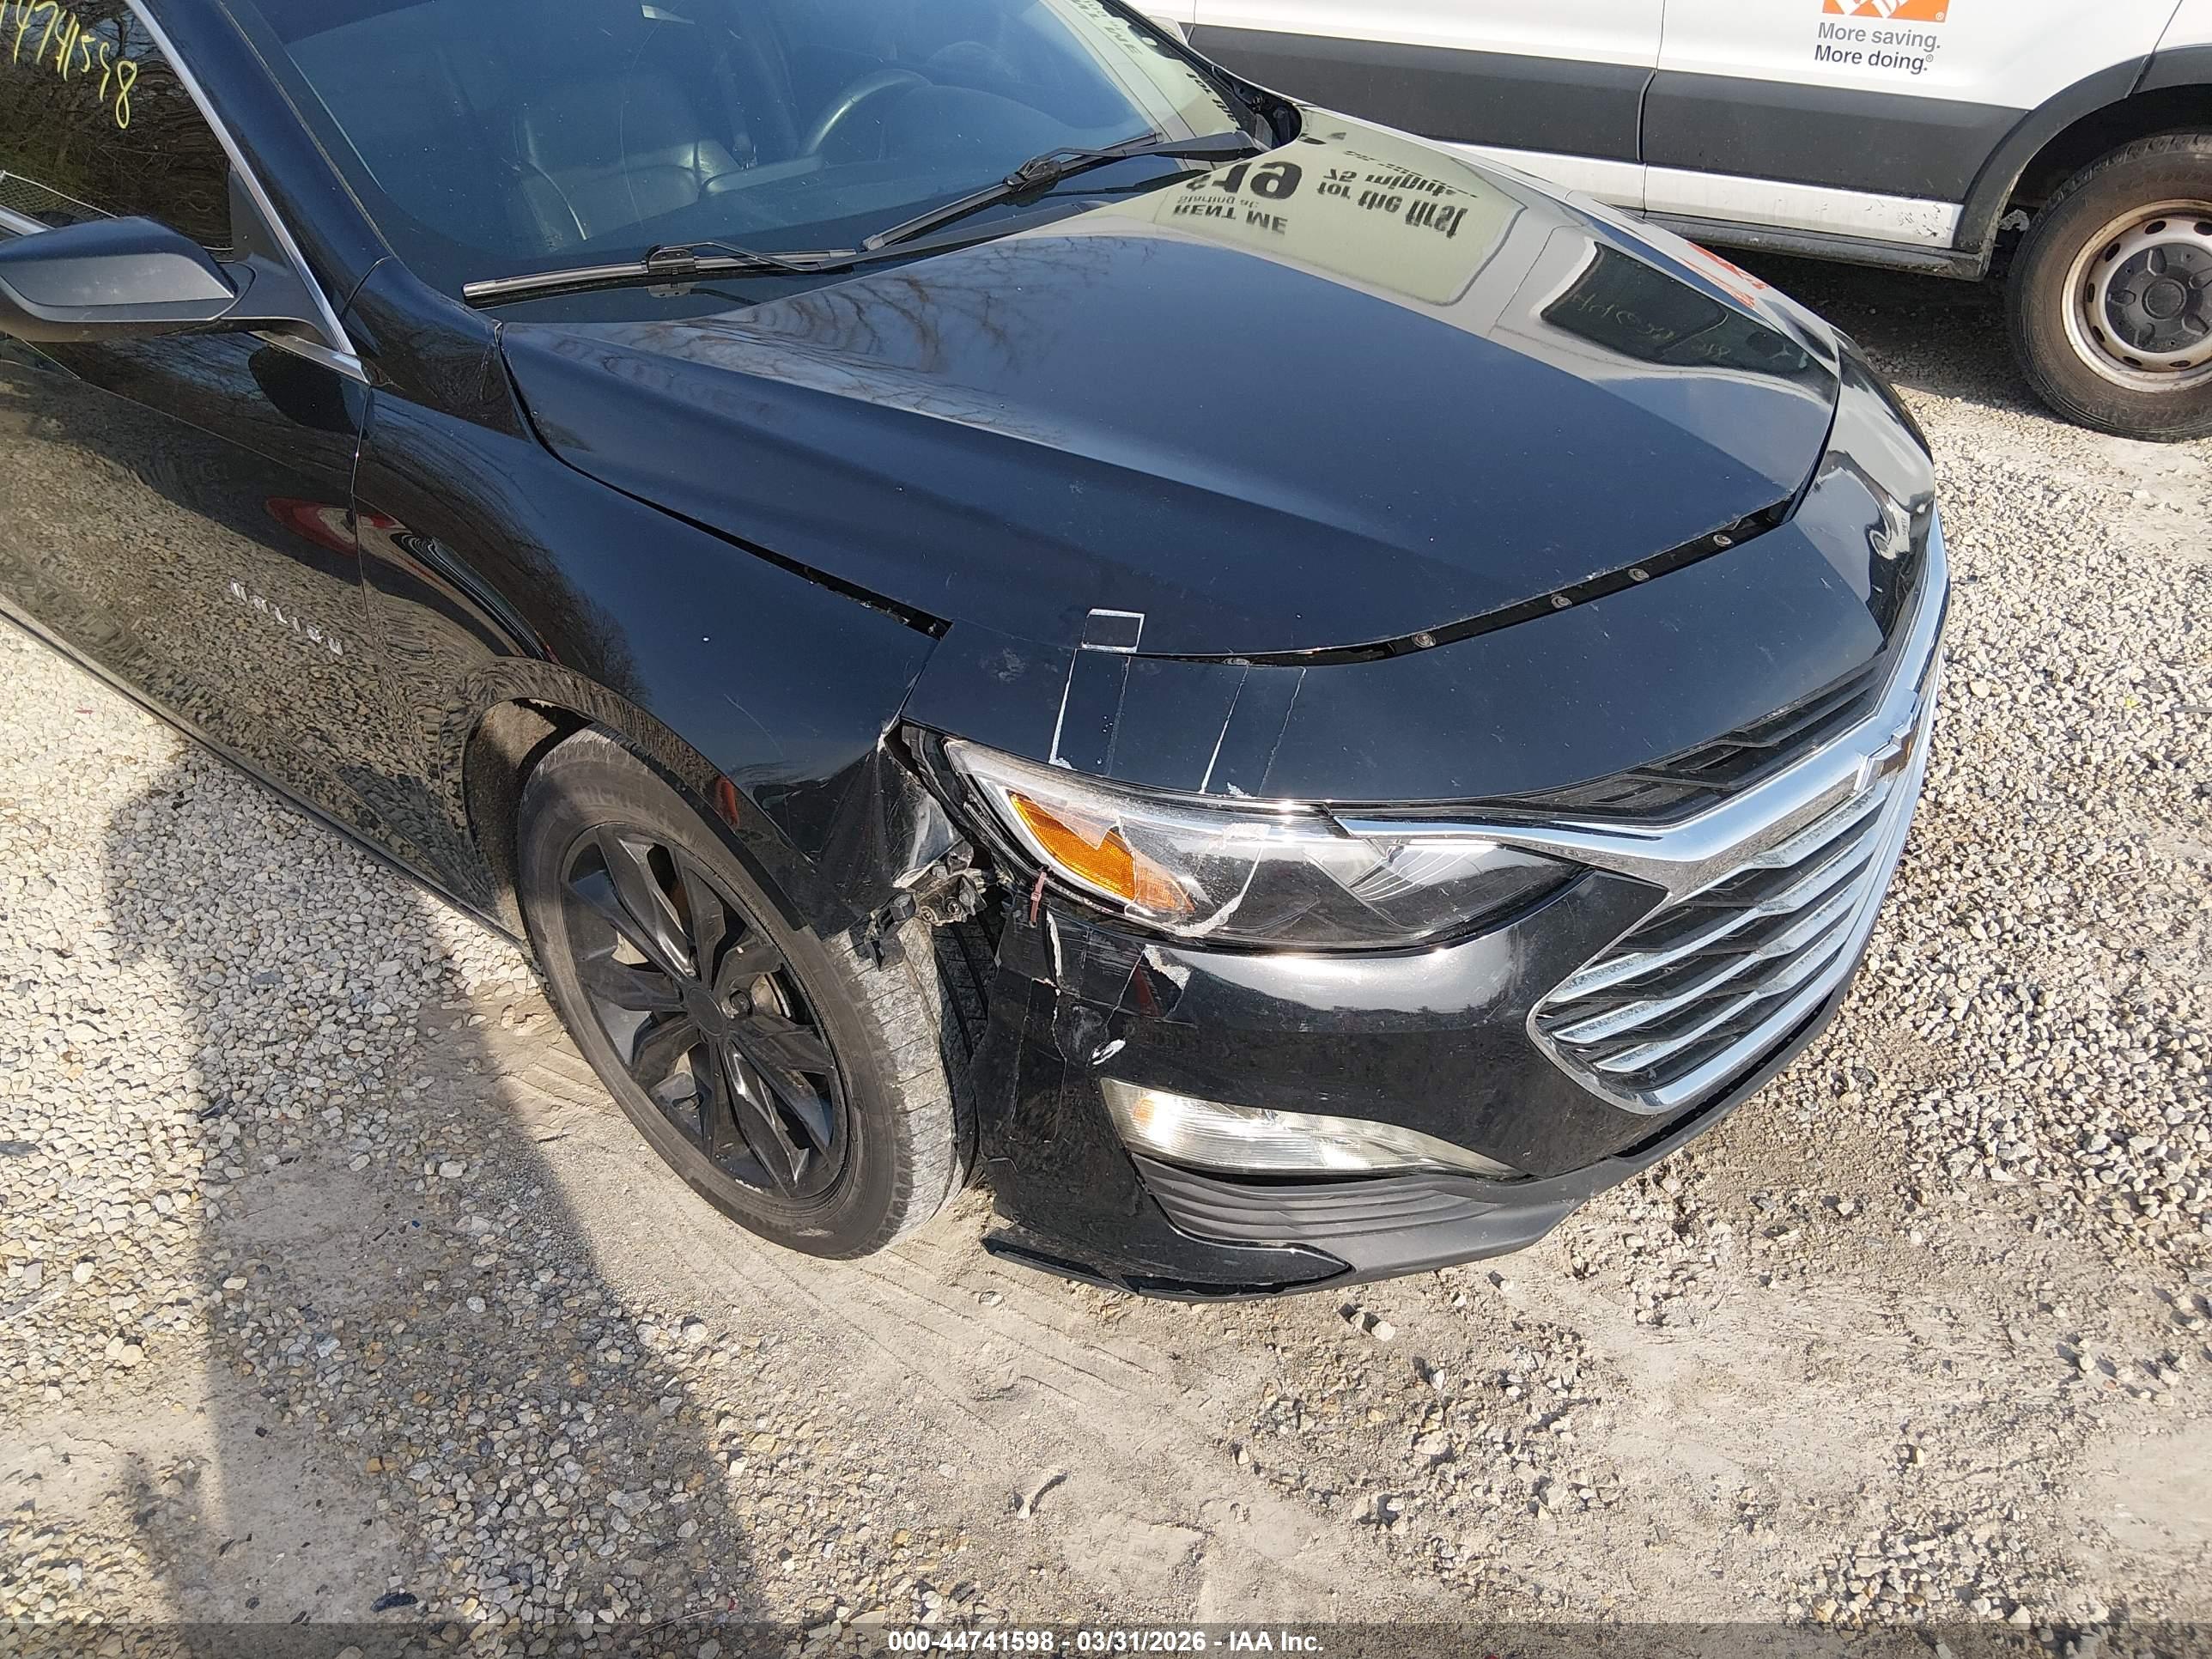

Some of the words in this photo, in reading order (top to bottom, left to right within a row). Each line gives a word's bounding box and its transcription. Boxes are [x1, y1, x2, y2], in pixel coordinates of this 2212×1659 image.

[1818, 21, 1867, 43] More
[1871, 29, 1941, 53] saving.
[1814, 45, 1863, 65] More
